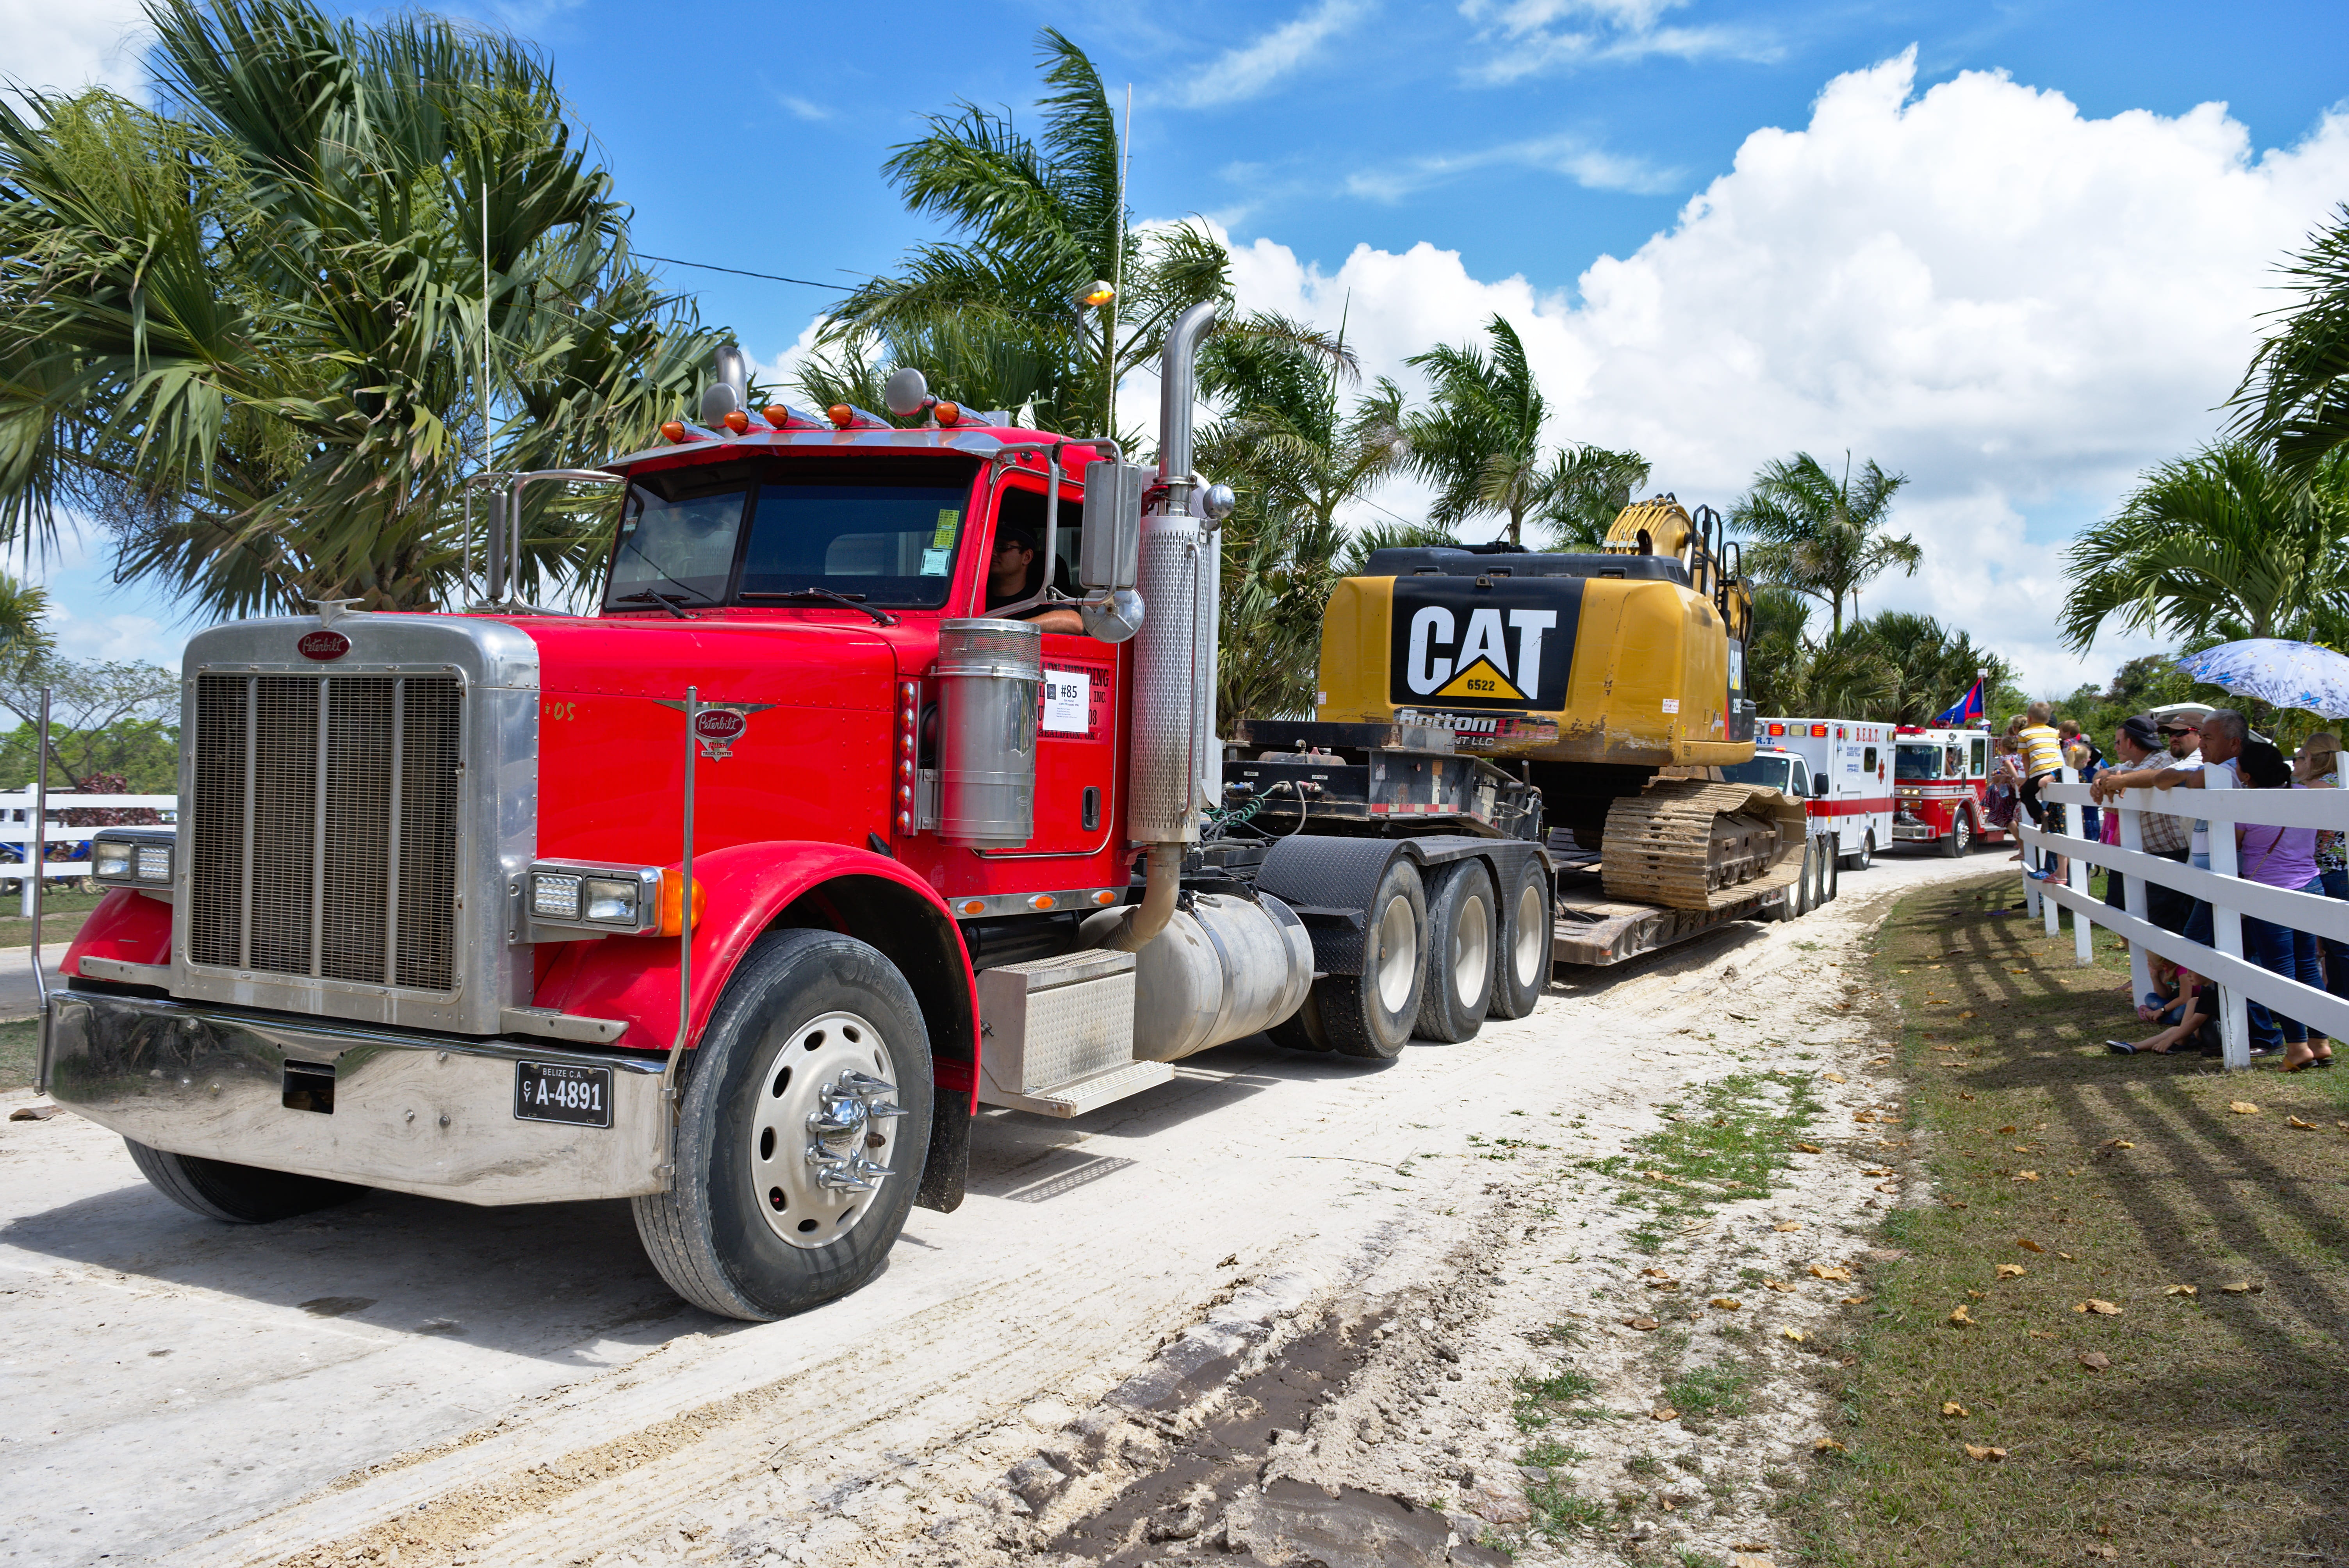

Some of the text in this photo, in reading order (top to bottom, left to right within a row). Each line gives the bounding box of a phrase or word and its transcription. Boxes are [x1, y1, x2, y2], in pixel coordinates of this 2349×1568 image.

[302, 636, 345, 654] Peterbilt
[1407, 606, 1557, 700] CAT
[1729, 649, 1742, 690] CAT
[1061, 684, 1077, 698] #85
[1467, 679, 1495, 691] 6522
[1094, 691, 1107, 703] INC.
[699, 715, 740, 731] Peterbilt
[1085, 732, 1095, 740] OK
[1471, 737, 1495, 746] LLC
[1856, 727, 1880, 742] B.E.R.T.
[708, 742, 727, 750] RUSH
[542, 1067, 584, 1079] BELIZE C.A.
[535, 1078, 602, 1111] A-4891
